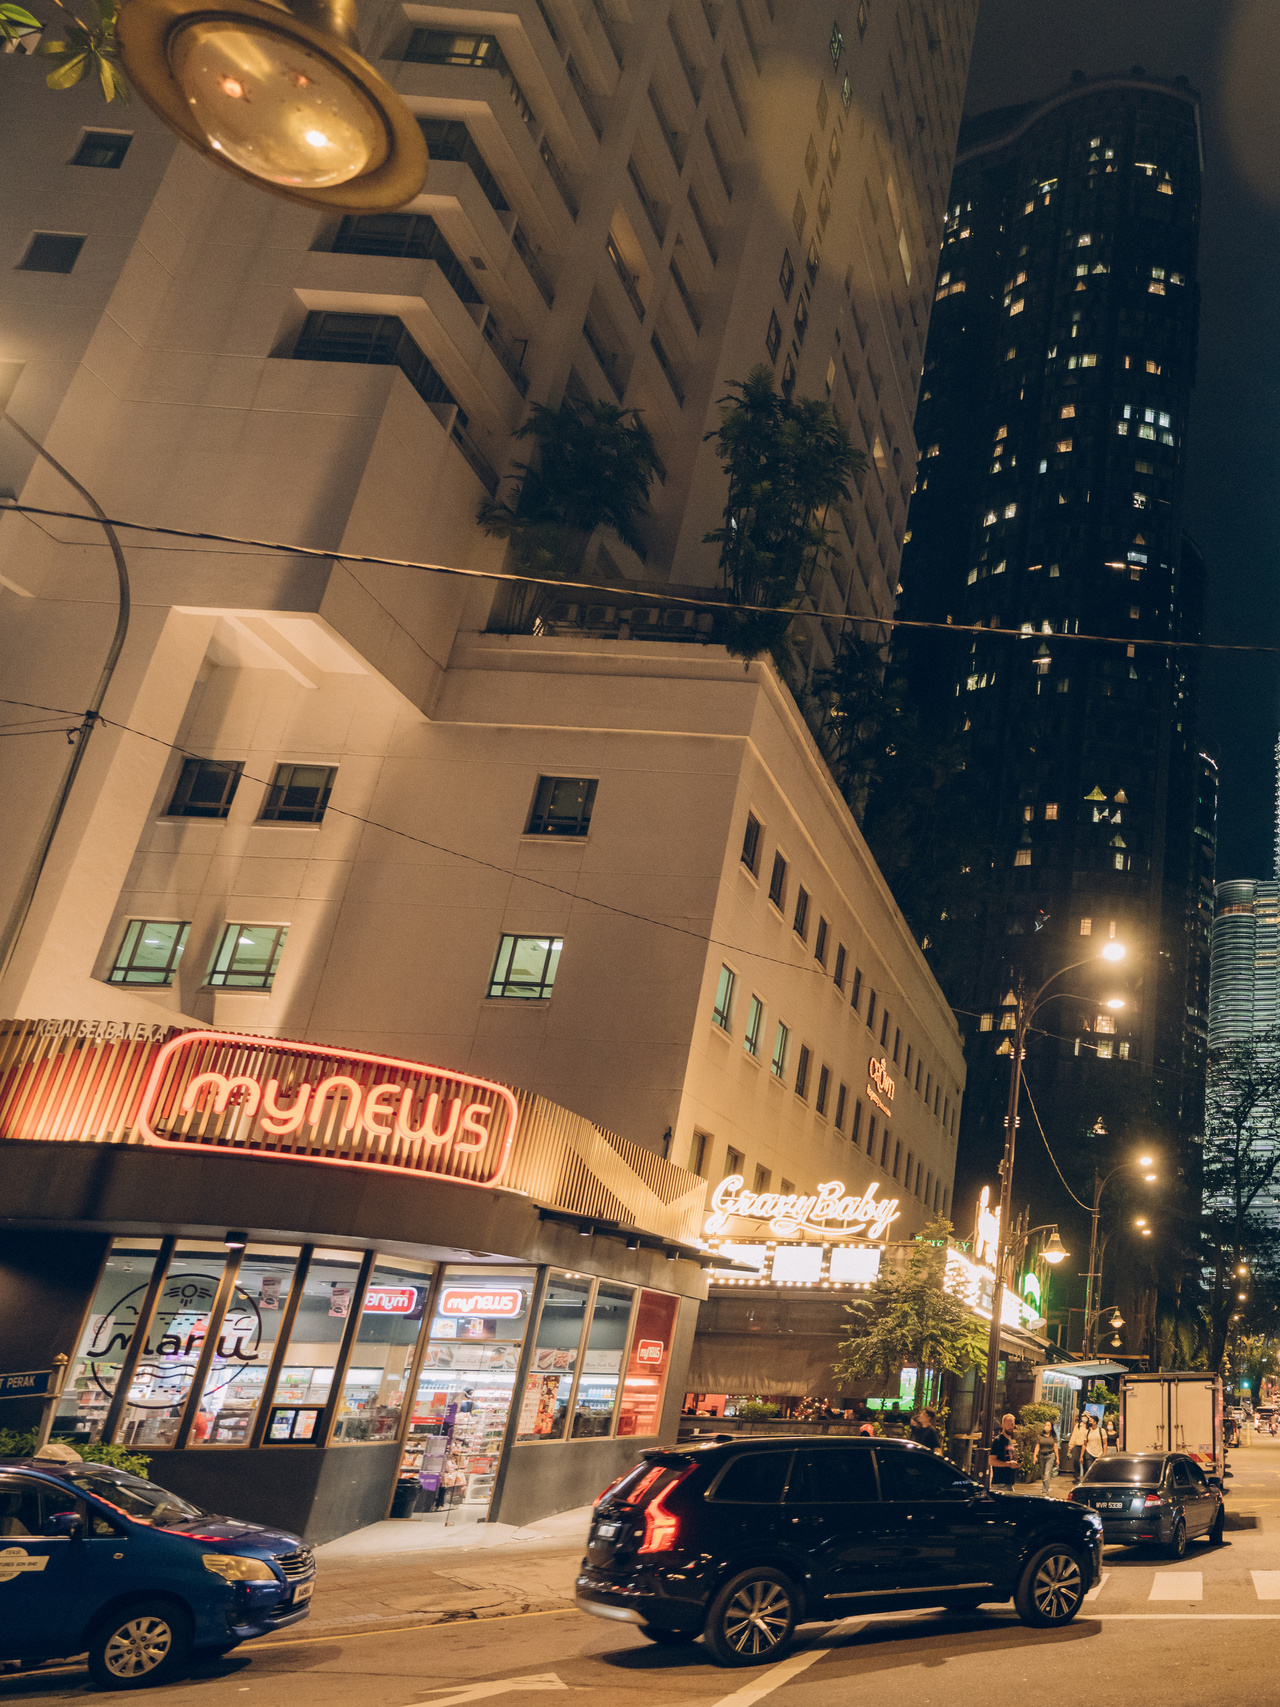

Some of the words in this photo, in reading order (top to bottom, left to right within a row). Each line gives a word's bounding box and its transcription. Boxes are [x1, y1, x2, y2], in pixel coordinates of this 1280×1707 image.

[37, 1020, 75, 1038] KEDAI
[77, 1021, 165, 1044] SERBANEKA
[704, 1174, 821, 1236] Gravy
[810, 1181, 901, 1239] Baby
[6, 1375, 36, 1388] PERAK
